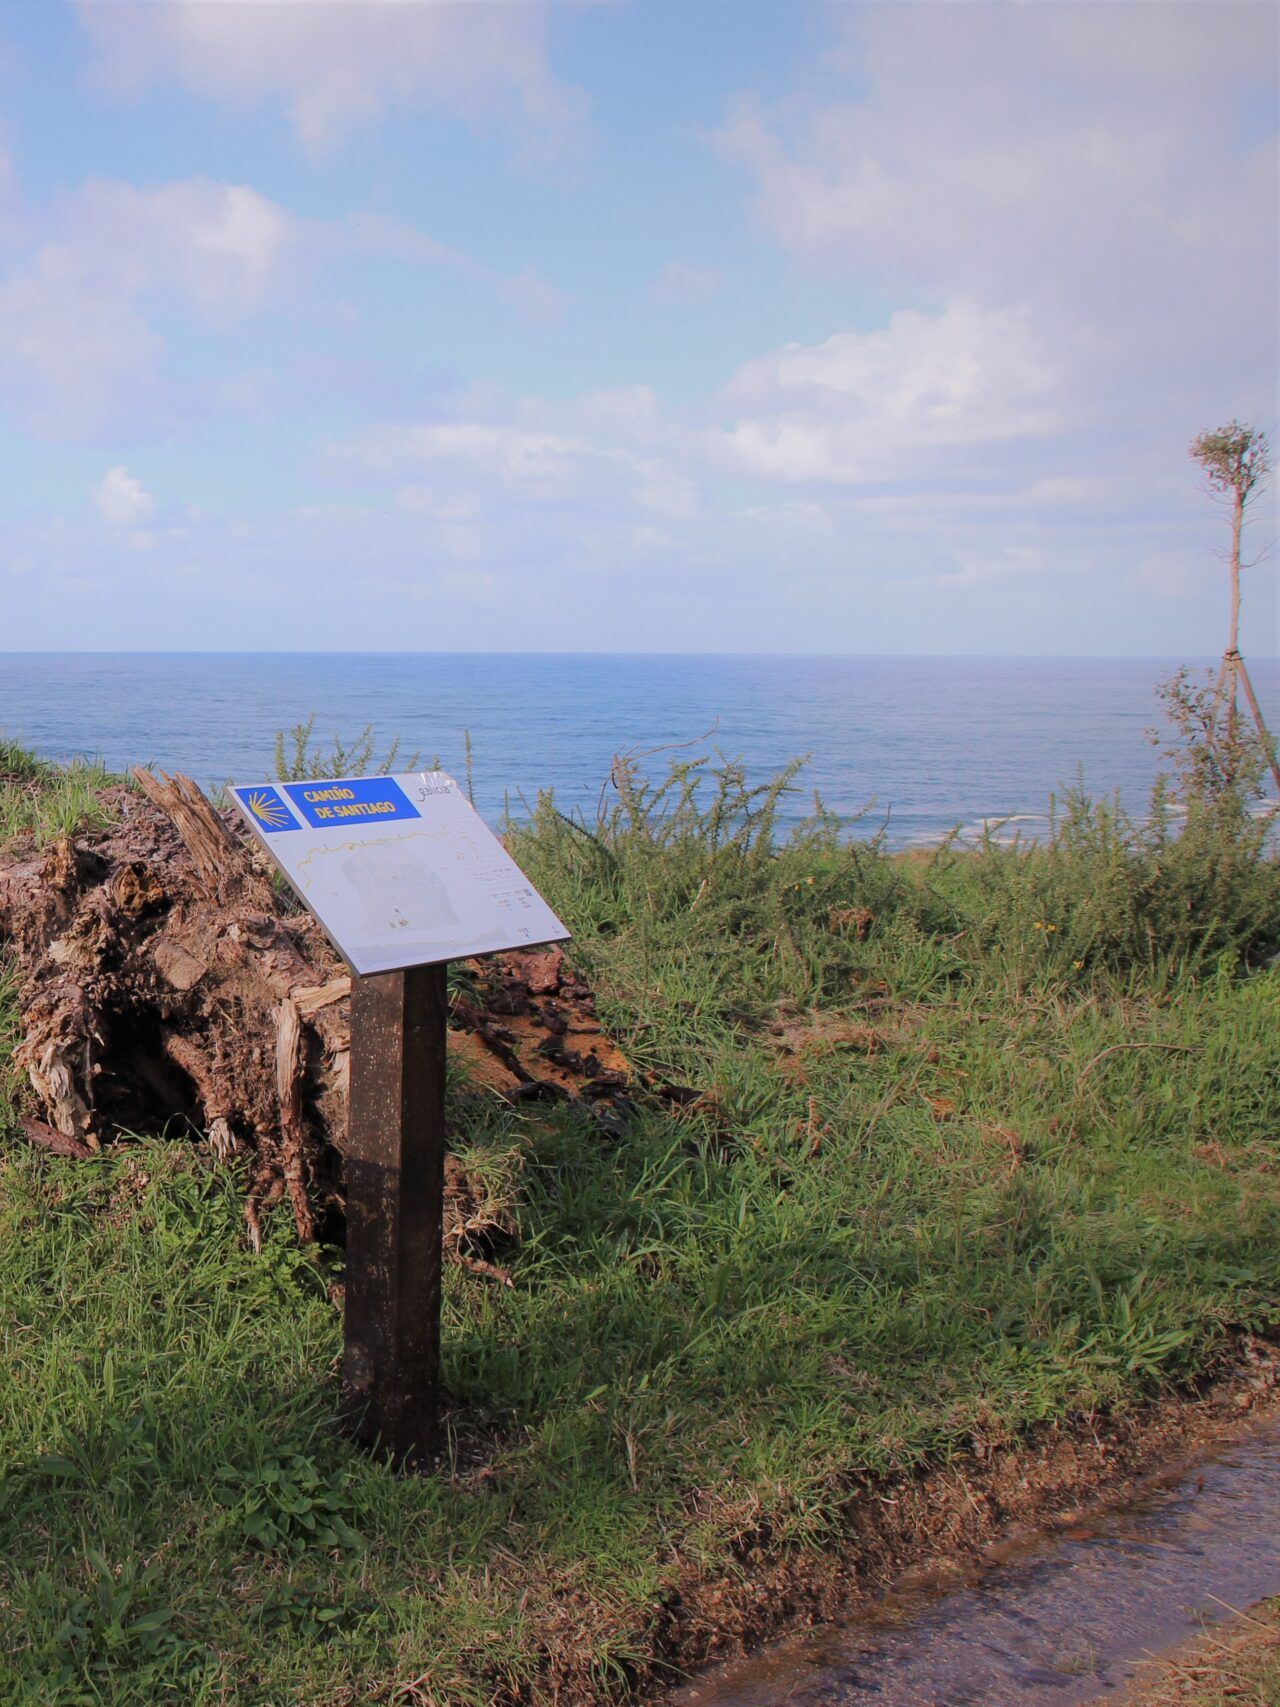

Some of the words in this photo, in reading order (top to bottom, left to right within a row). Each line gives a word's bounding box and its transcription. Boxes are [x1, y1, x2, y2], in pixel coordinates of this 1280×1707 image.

[303, 786, 355, 803] CAMIÑO
[416, 786, 451, 803] galicia
[316, 806, 333, 819] DE
[334, 801, 396, 817] SANTIAGO
